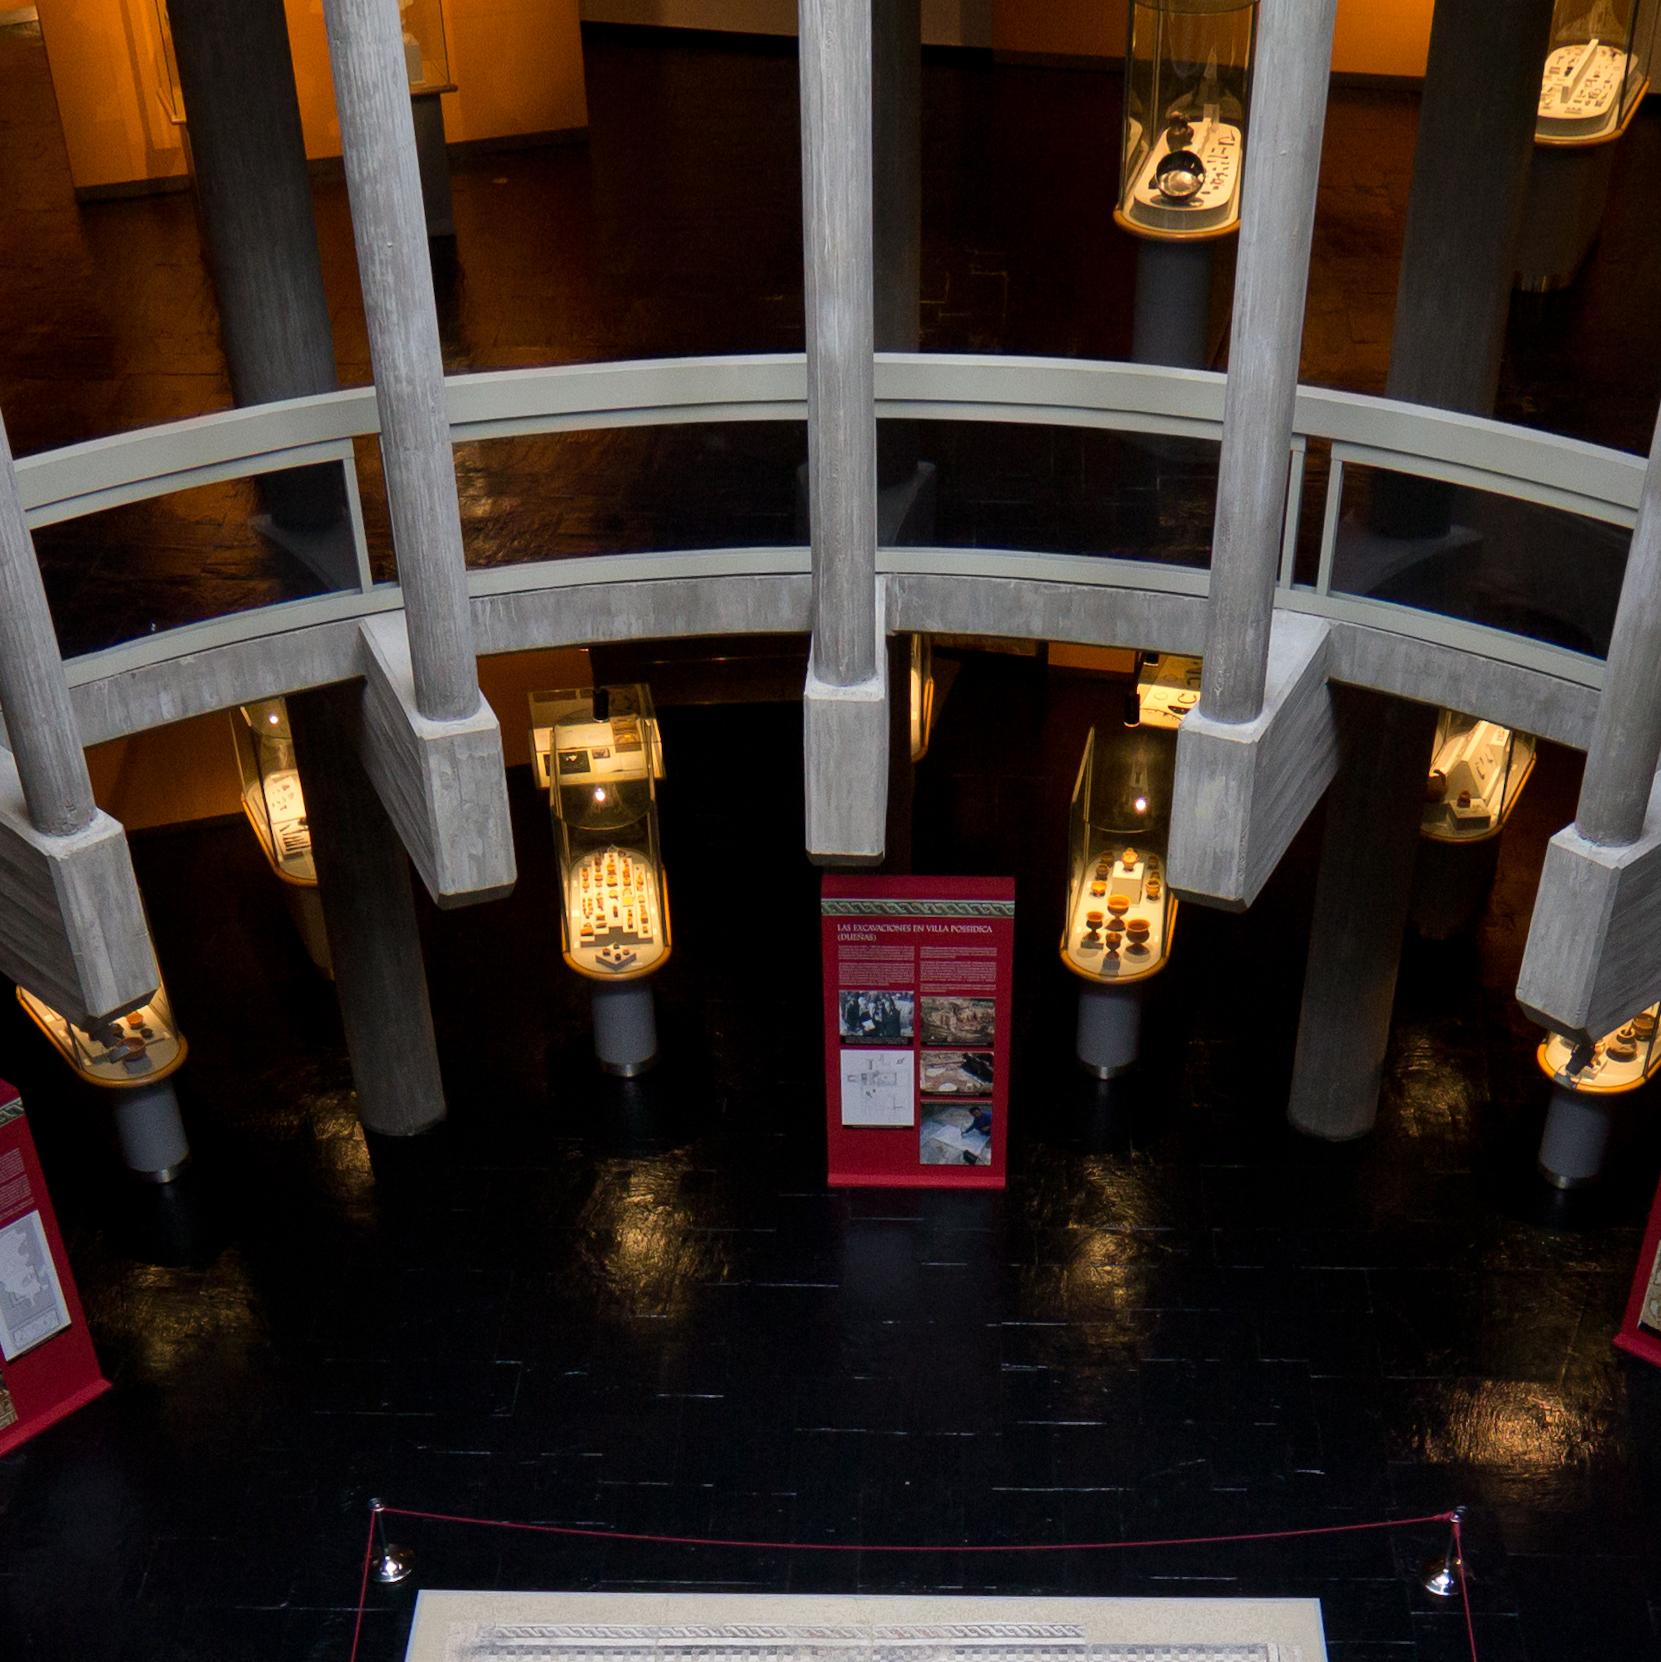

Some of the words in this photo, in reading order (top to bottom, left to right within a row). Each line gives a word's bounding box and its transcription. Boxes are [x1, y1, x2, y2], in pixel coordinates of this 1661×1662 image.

[837, 923, 851, 932] LAS
[853, 923, 911, 933] EXCAVACIONES
[912, 924, 924, 933] EN
[925, 924, 950, 933] VILLA
